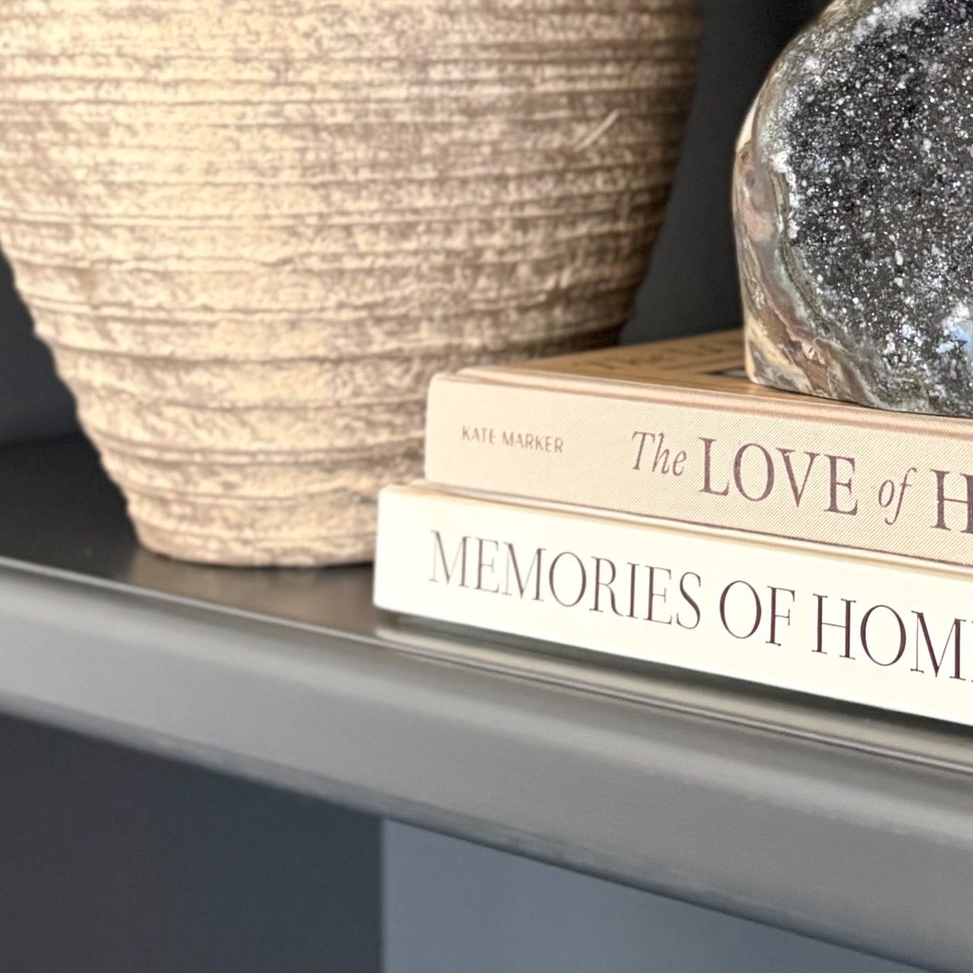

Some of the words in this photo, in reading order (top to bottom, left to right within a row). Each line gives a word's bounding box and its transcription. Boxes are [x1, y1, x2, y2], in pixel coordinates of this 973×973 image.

[461, 425, 497, 445] KATE
[502, 431, 564, 454] MARKER
[631, 431, 687, 476] The
[699, 437, 858, 516] LOVE
[877, 467, 917, 525] of
[428, 531, 701, 629] MEMORIES
[719, 580, 795, 646] OF
